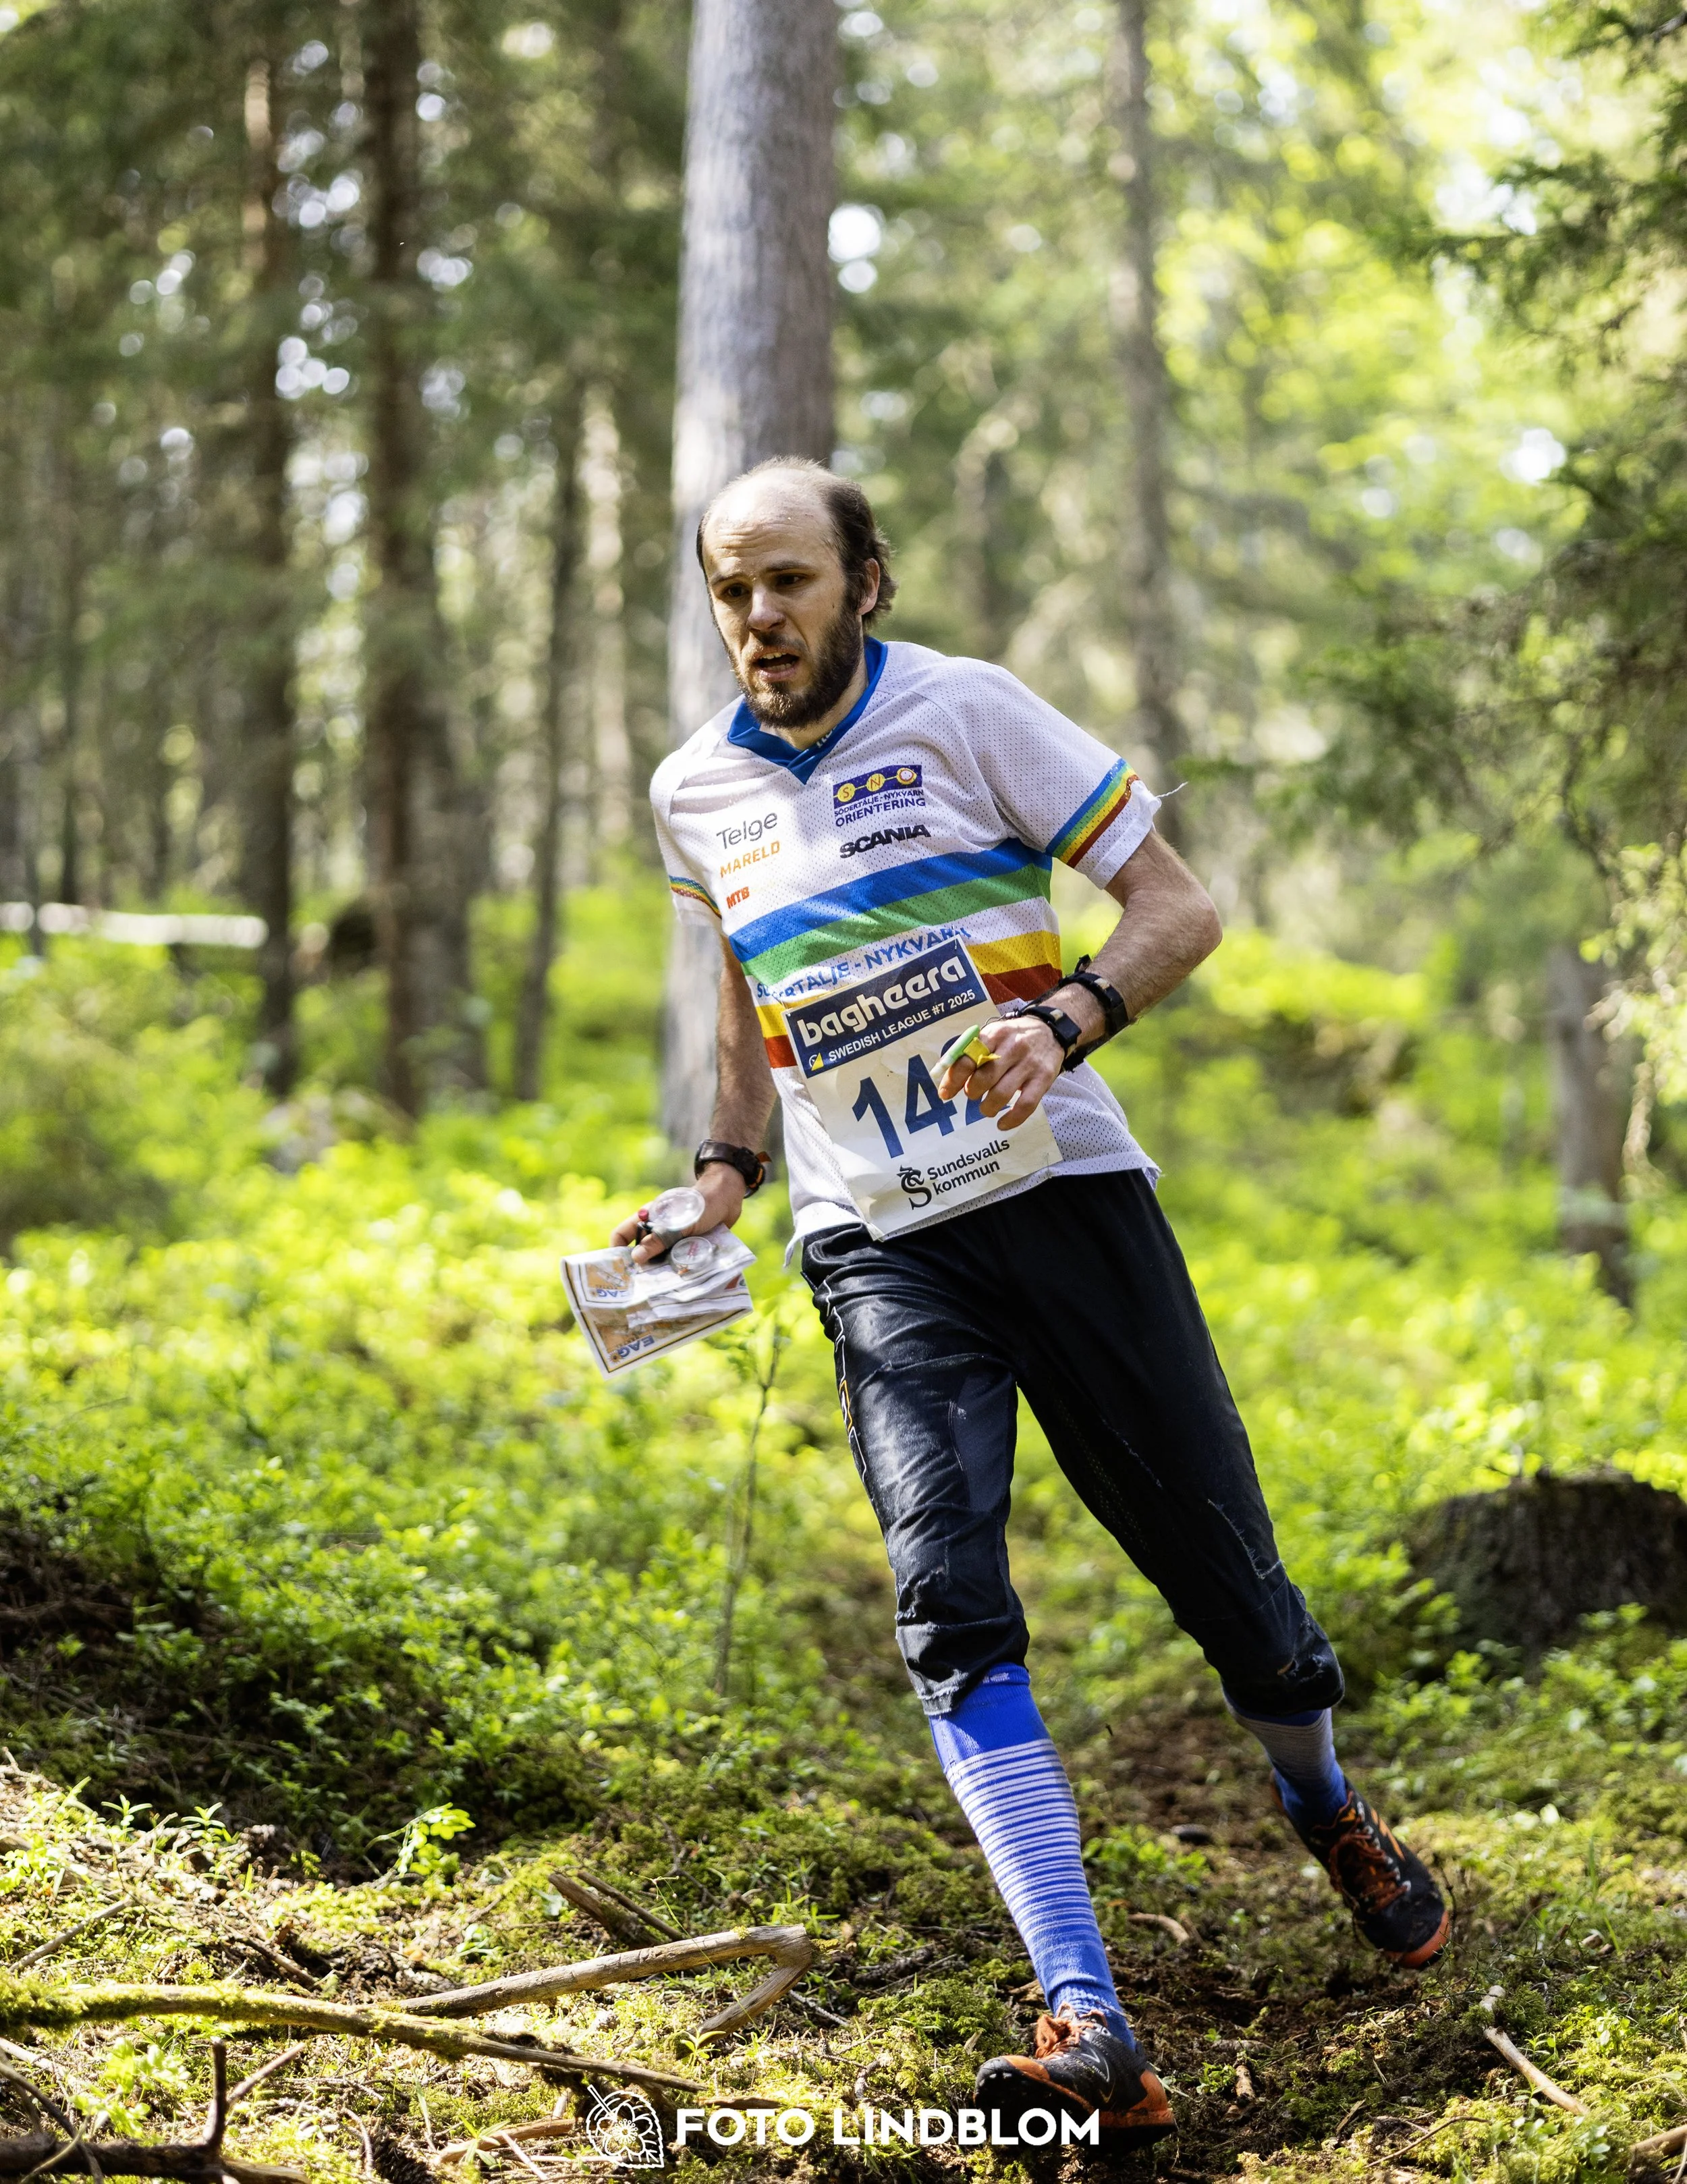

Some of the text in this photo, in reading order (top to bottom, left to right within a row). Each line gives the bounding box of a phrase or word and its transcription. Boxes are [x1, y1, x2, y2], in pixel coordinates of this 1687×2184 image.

[835, 798, 925, 827] ORIENTERING
[716, 813, 777, 849] Telge
[839, 824, 931, 858] SCANIA
[720, 840, 780, 878] MARELD
[726, 886, 750, 909] MTB
[797, 956, 967, 1047] bagheera
[828, 989, 976, 1062] SWEDISH LEAGUE #7 2025
[927, 1139, 1010, 1180] Sundsvalls
[933, 1160, 1000, 1195] kommun
